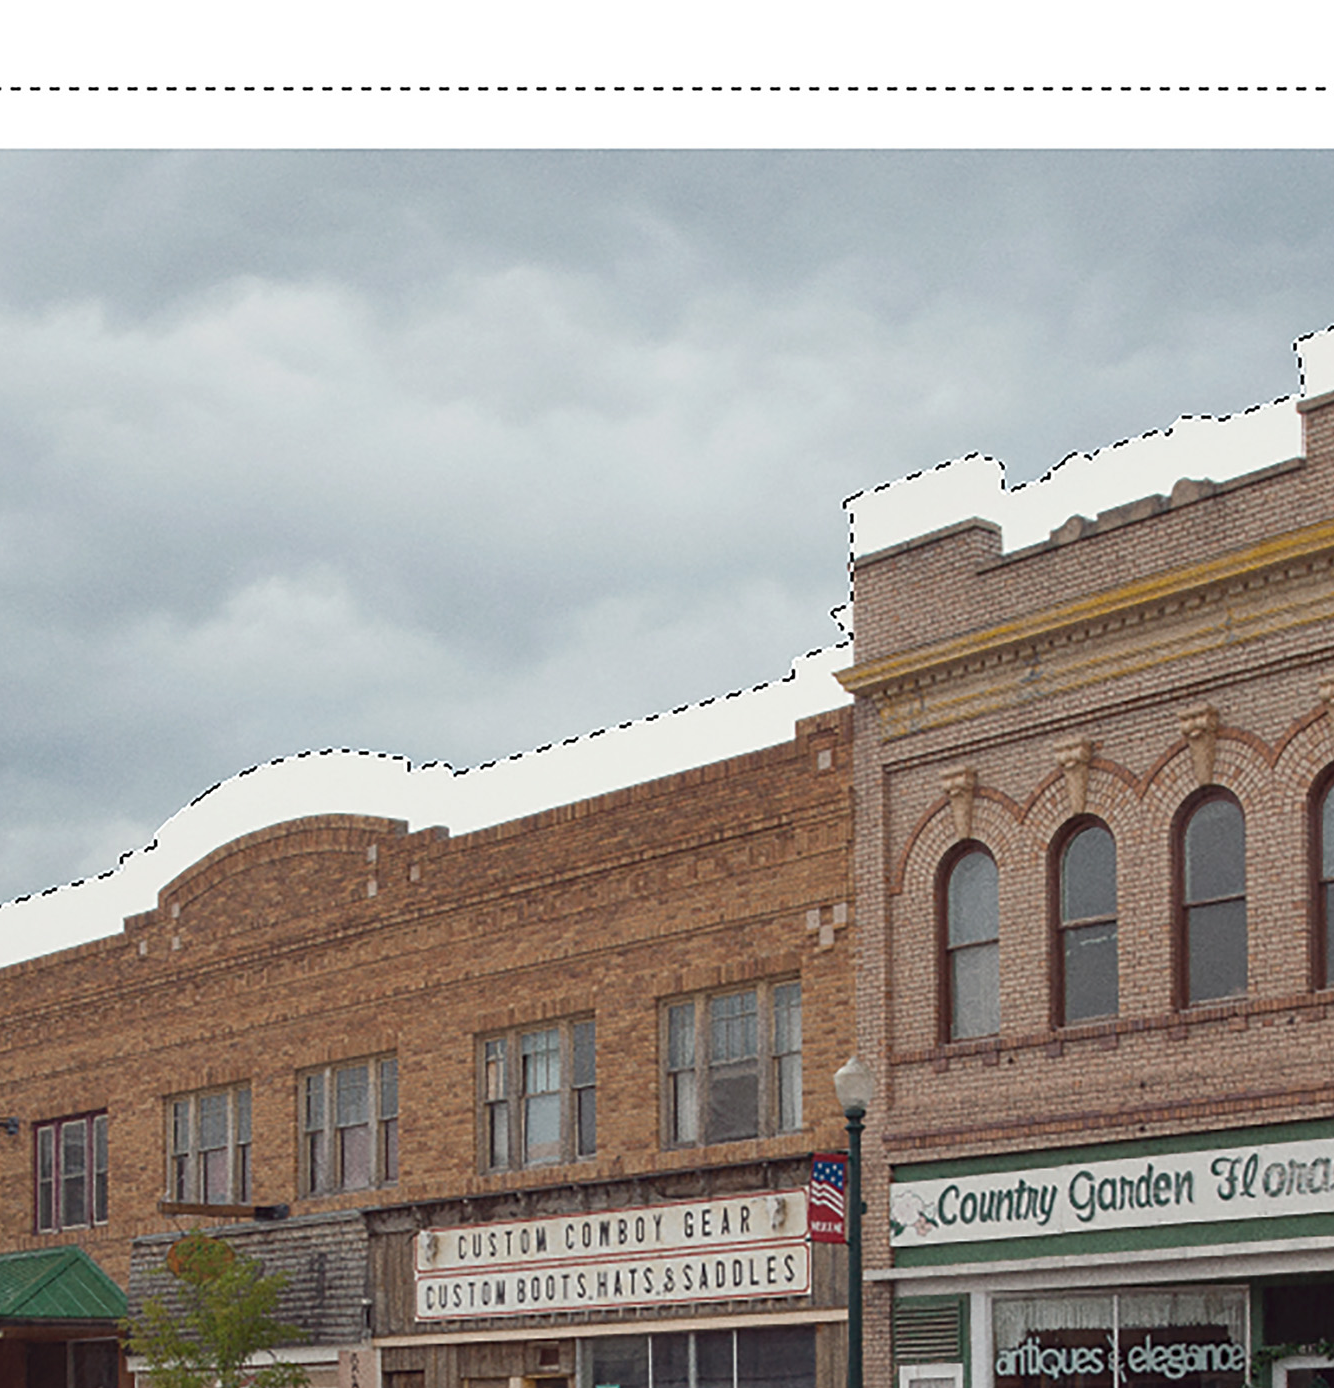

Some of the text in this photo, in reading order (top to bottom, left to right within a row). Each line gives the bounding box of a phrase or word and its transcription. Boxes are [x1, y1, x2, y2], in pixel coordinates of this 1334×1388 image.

[938, 1179, 1058, 1226] Country
[1069, 1163, 1194, 1222] Garden
[458, 1205, 751, 1259] CUSTOM COWBOY GEAR
[426, 1280, 506, 1310] CUSTOM
[1127, 1333, 1245, 1380] elegance
